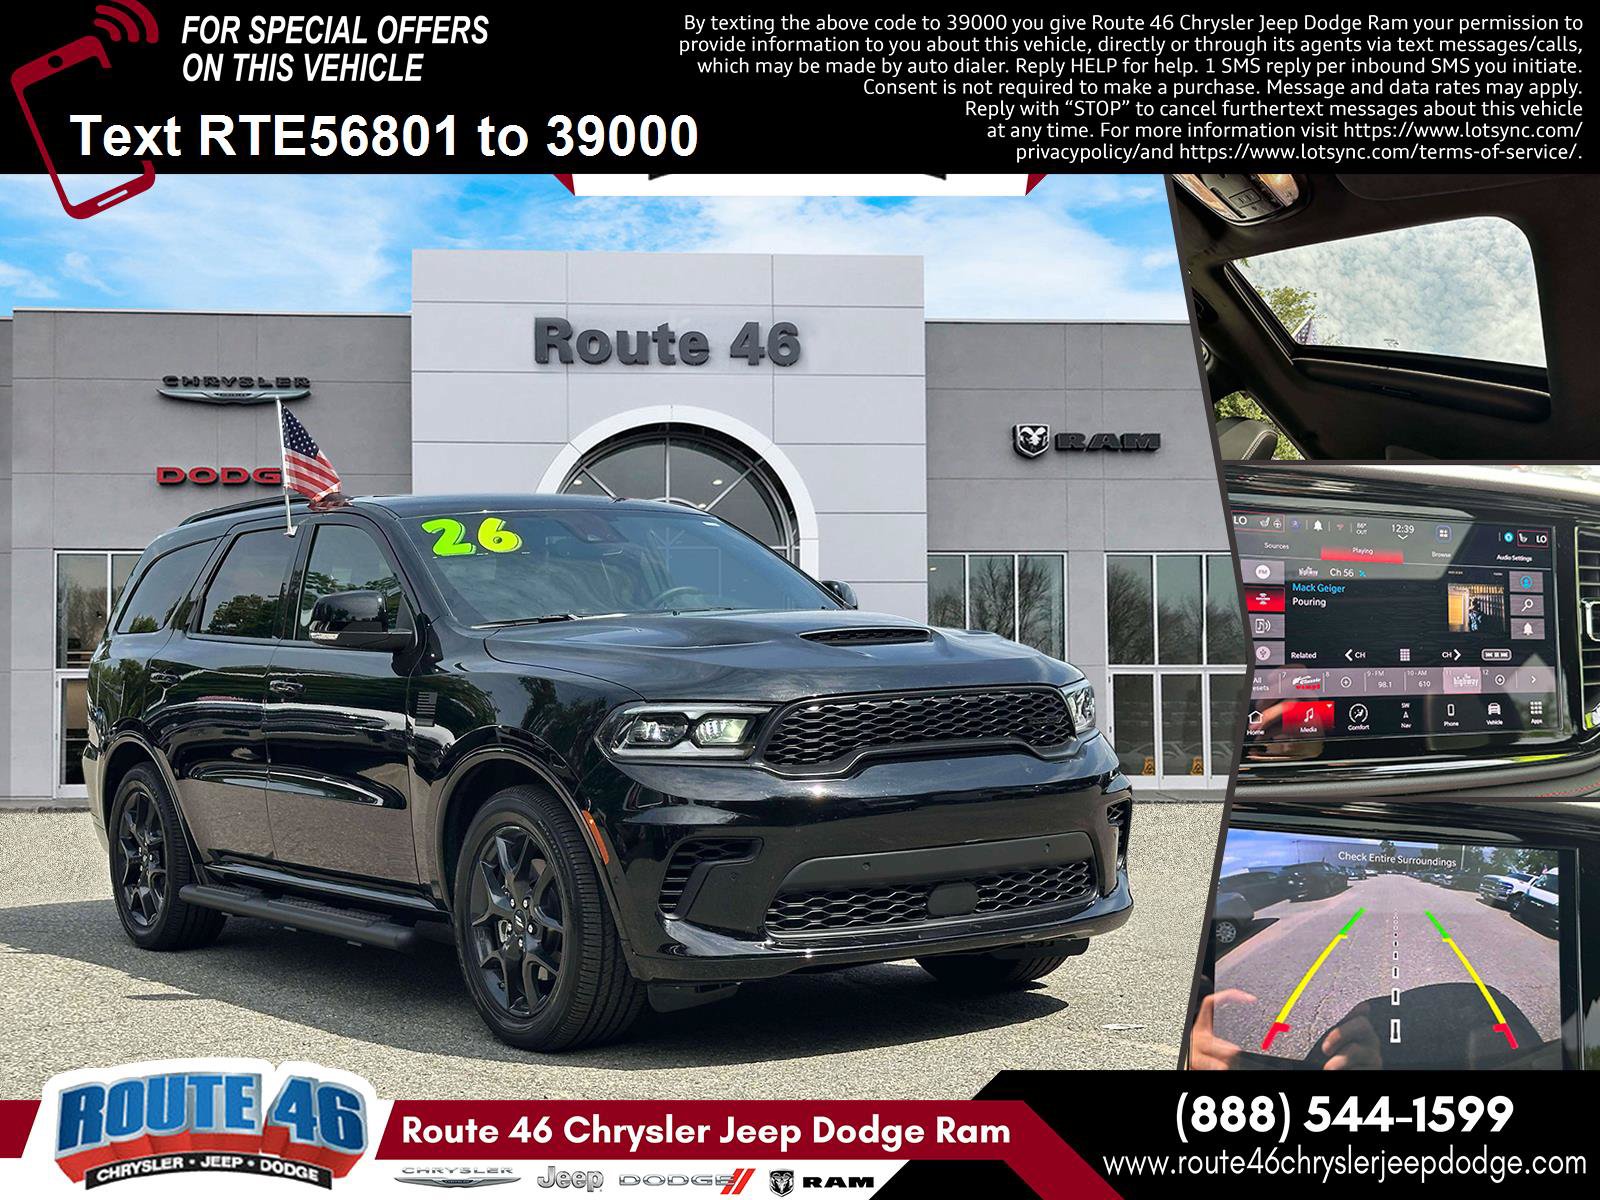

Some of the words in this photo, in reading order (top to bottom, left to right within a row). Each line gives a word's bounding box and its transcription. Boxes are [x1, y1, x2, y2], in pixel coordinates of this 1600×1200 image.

[534, 317, 710, 366] Route
[730, 321, 801, 367] 46
[162, 375, 311, 388] CHRYSLER
[1054, 432, 1161, 453] RAM
[156, 467, 283, 486] DODG
[1233, 516, 1247, 525] LO
[1392, 524, 1415, 534] 12:39
[421, 517, 523, 556] 26
[1536, 535, 1547, 543] LO
[1264, 542, 1289, 550] Sources
[1352, 547, 1374, 556] Playing
[1512, 555, 1532, 563] Settings
[1330, 568, 1341, 576] Ch
[1343, 569, 1354, 577] 56
[1292, 583, 1315, 592] Mack
[1317, 584, 1345, 594] Geiger
[1292, 597, 1326, 608] Pouring
[1355, 651, 1366, 659] CH
[1338, 851, 1367, 861] Check
[1369, 854, 1395, 863] Entire
[1398, 855, 1456, 868] Surroundings
